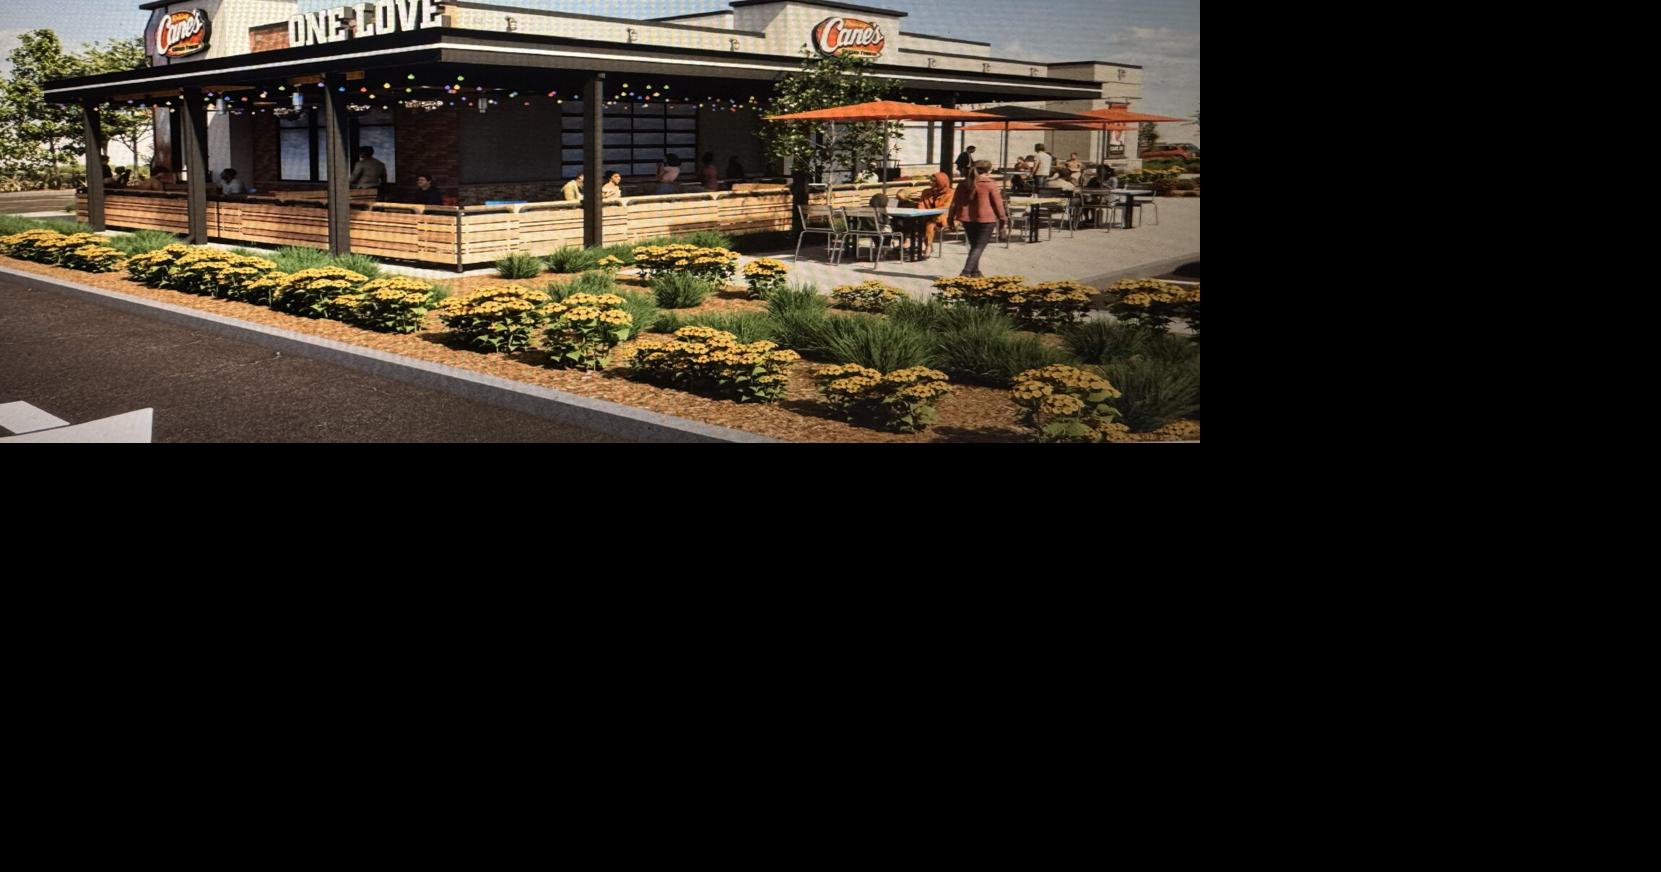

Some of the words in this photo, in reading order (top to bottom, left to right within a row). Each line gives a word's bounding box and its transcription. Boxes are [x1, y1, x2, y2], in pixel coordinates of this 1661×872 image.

[156, 9, 203, 55] Cane's
[288, 6, 346, 48] ONE
[352, 0, 442, 38] LOVE
[820, 17, 884, 53] Cane's
